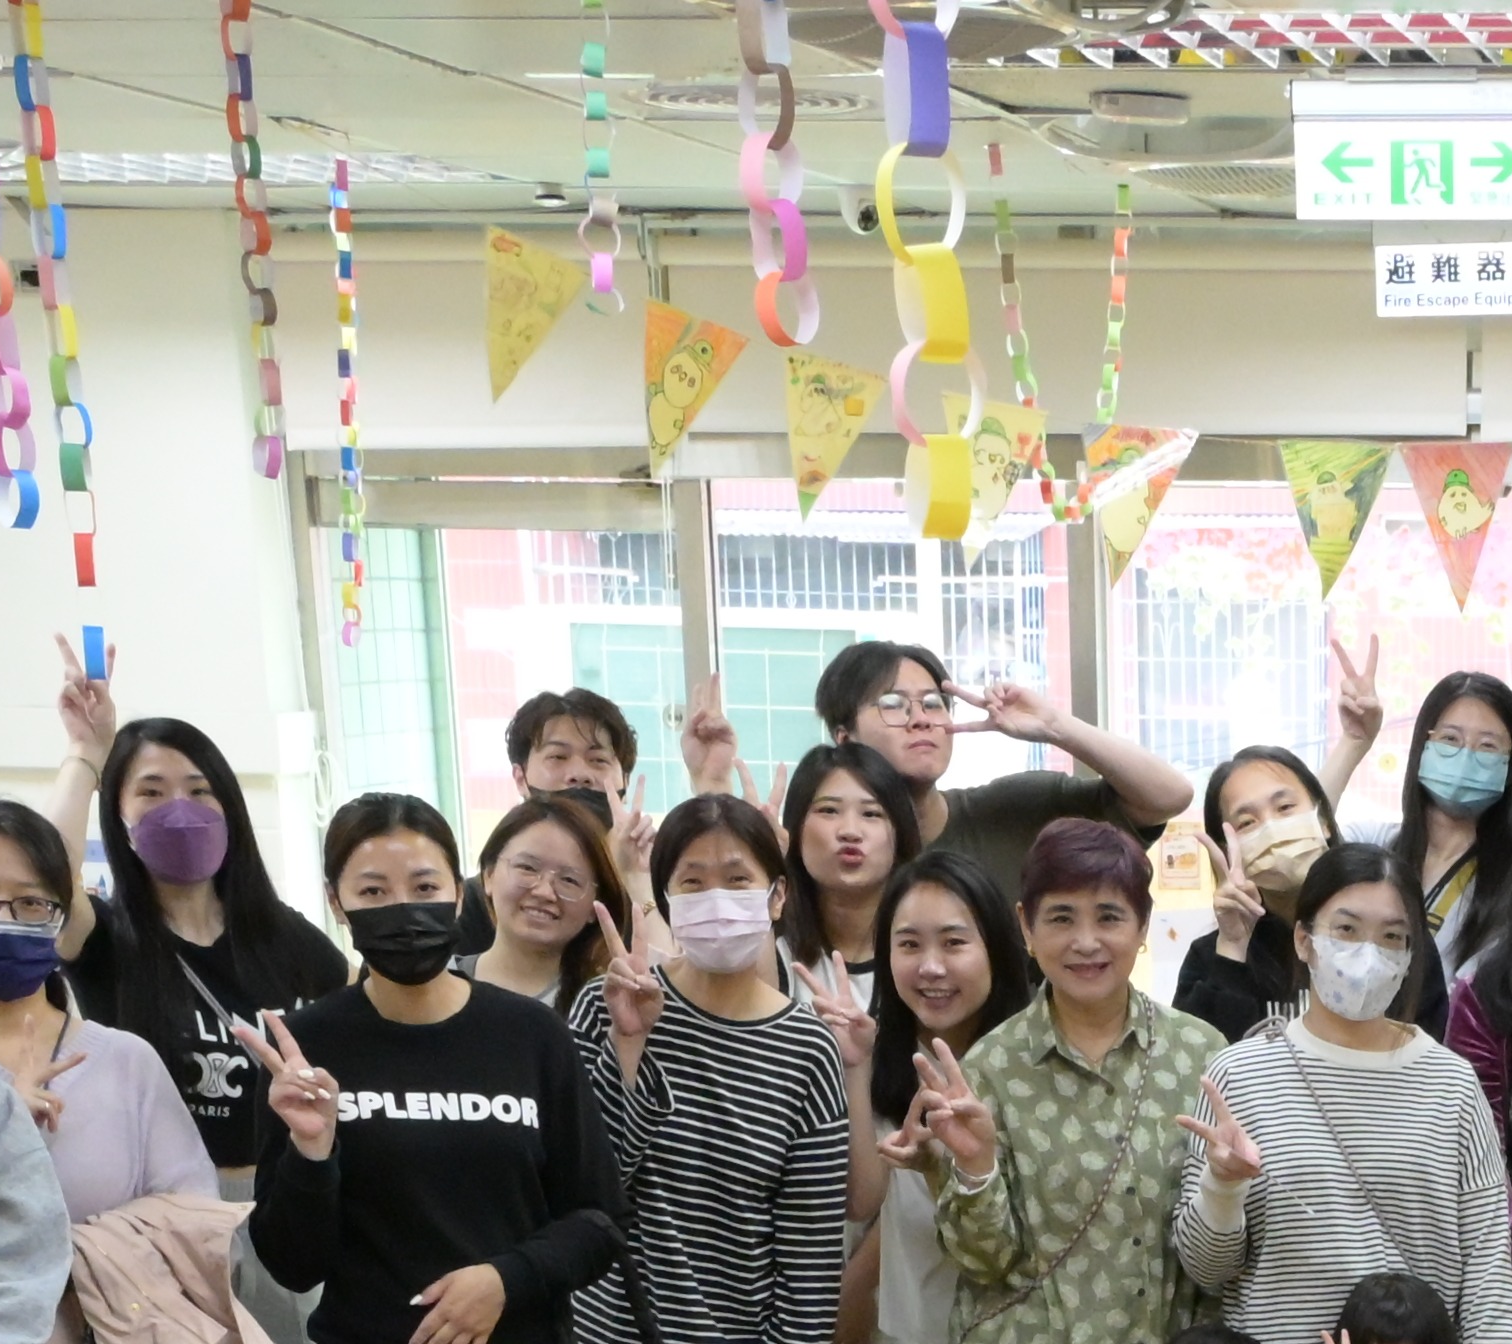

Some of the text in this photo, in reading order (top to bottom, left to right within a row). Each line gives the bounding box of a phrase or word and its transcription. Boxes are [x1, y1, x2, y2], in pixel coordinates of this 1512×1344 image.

[1314, 192, 1372, 205] EXIT
[1384, 294, 1411, 307] Fire
[1417, 294, 1469, 308] Escape
[337, 1090, 540, 1129] SPLENDOR
